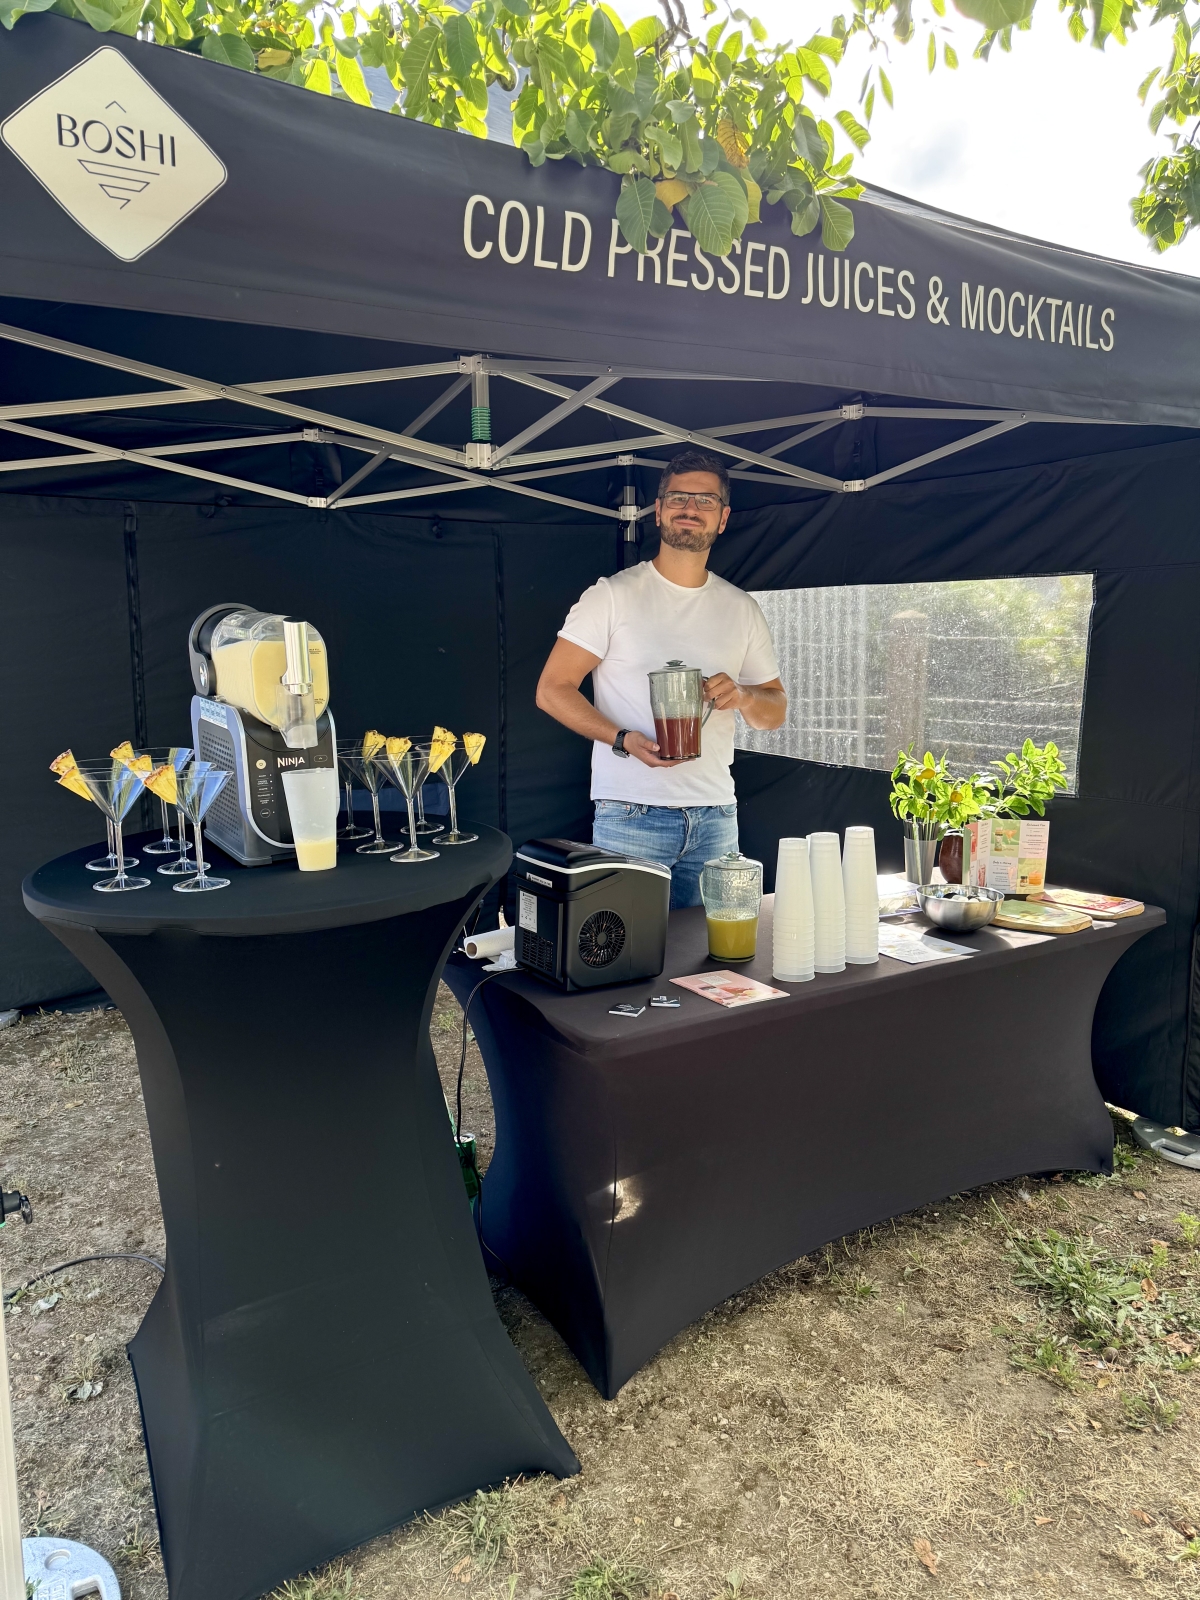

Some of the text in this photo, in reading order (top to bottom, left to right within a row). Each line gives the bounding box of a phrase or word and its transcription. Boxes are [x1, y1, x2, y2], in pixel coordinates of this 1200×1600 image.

[56, 113, 176, 167] BOSHI
[463, 194, 592, 272] COLD
[801, 252, 916, 320] JUICES
[926, 275, 951, 326] &
[961, 282, 1116, 352] MOCKTAILS
[277, 756, 306, 768] NINJA
